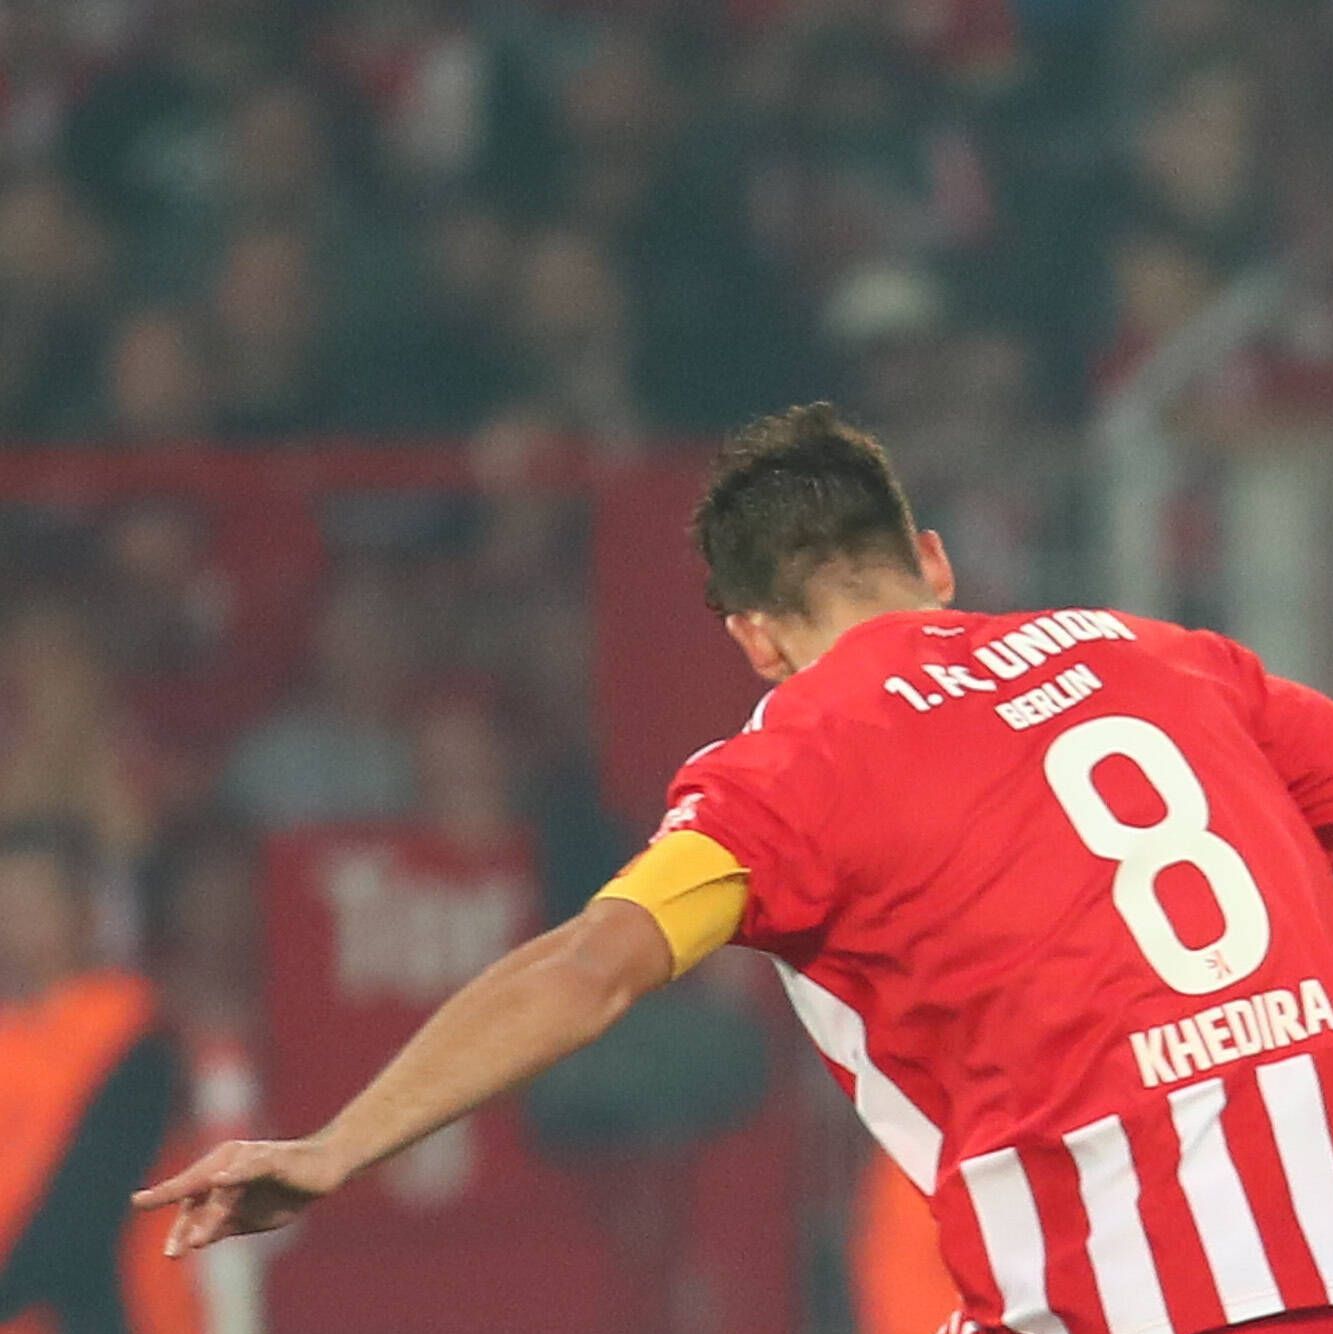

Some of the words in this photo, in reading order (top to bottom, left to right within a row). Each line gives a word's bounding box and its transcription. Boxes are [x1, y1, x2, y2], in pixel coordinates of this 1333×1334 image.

[973, 609, 1137, 680] UNION
[994, 663, 1103, 731] BERLIN
[1044, 716, 1270, 996] 8
